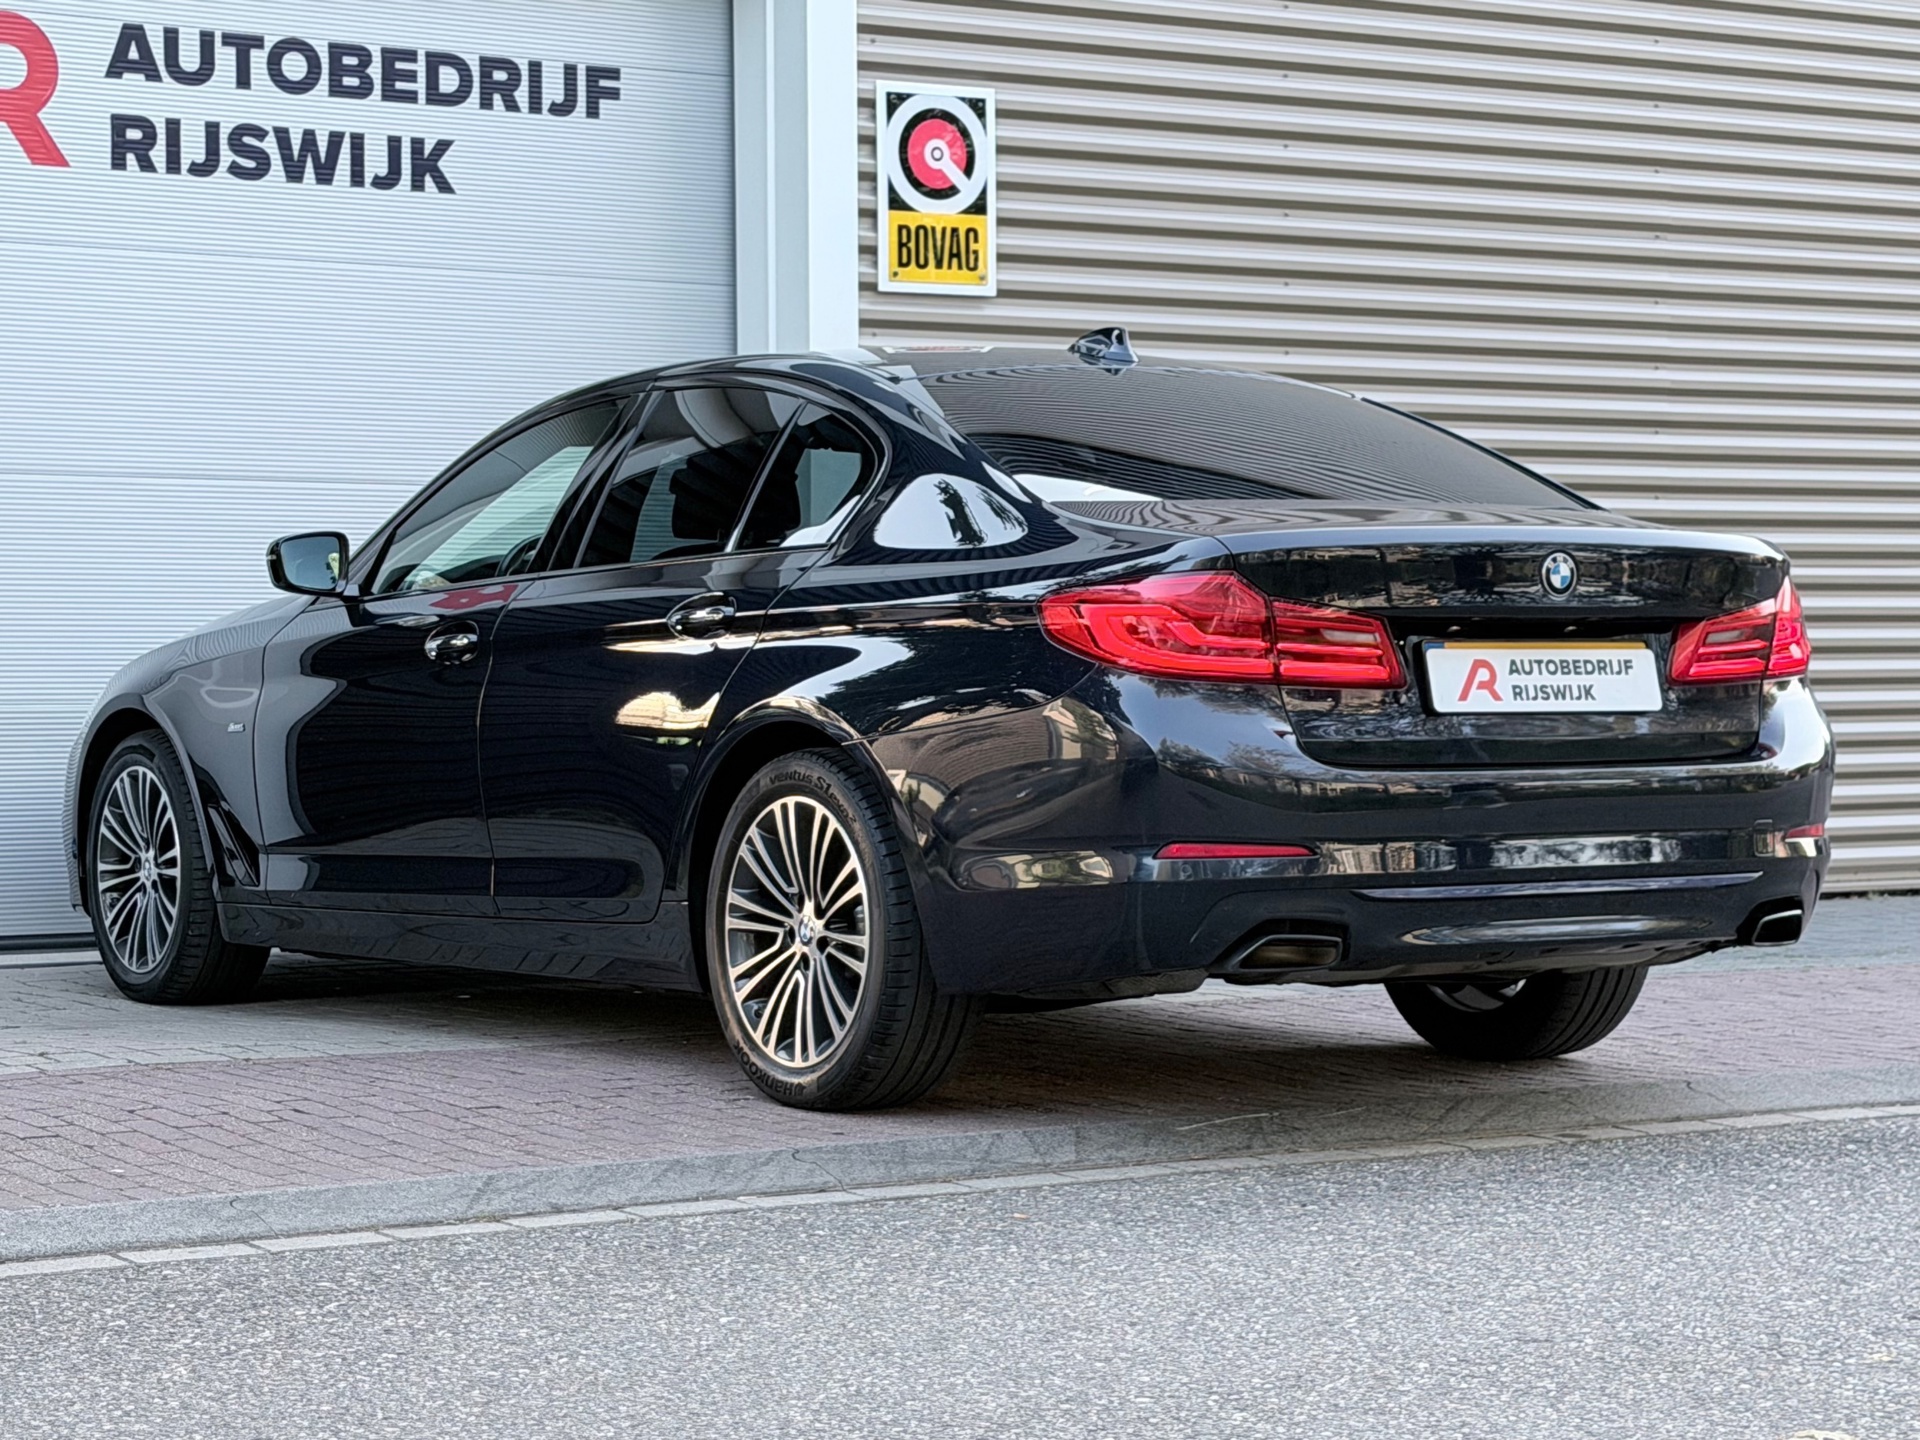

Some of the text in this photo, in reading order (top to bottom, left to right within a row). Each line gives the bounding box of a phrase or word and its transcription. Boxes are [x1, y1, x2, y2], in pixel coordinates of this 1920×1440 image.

[104, 22, 622, 119] AUTOBEDRIJF
[109, 112, 457, 195] RIJSWIJK
[896, 223, 980, 272] BOVAG
[1508, 658, 1634, 676] AUTOBEDRIJF
[1513, 684, 1596, 702] RIJSWIJK
